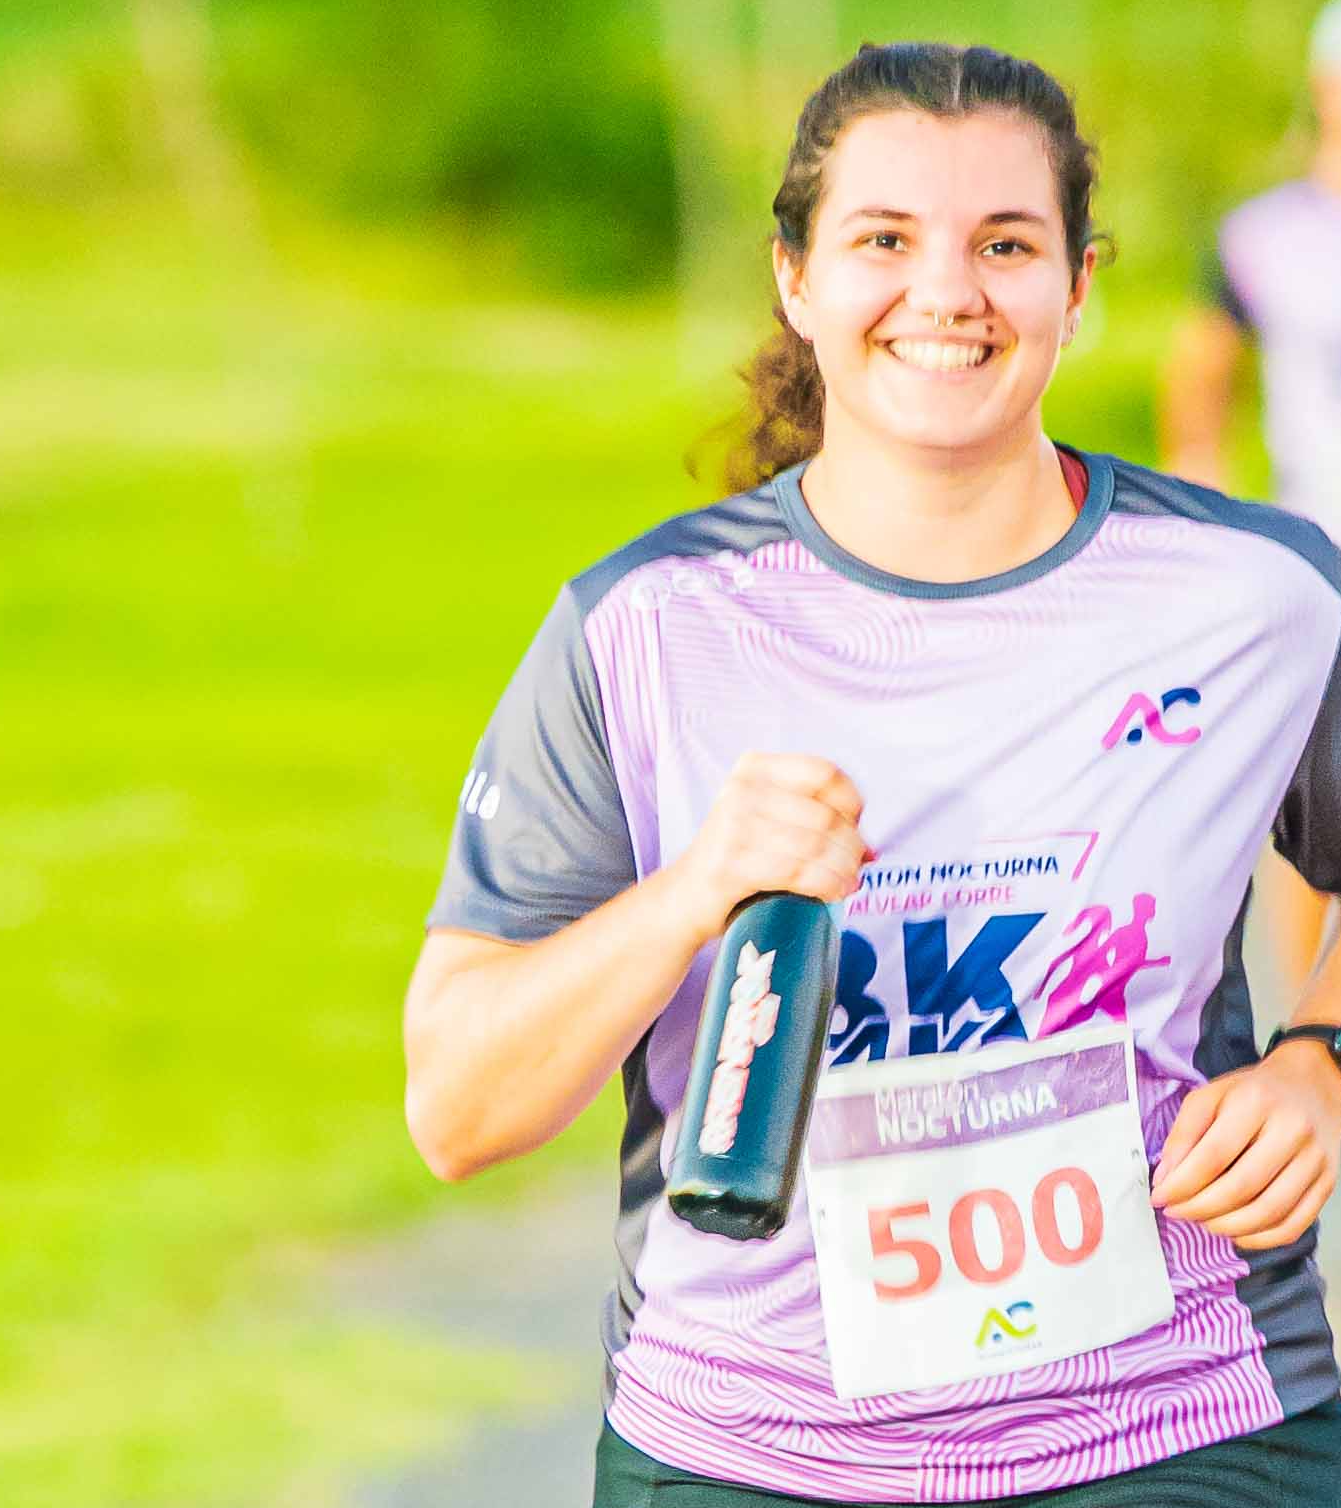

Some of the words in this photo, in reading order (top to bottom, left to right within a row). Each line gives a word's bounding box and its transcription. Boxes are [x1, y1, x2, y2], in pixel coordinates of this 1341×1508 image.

[859, 865, 921, 891] ATON
[930, 855, 1060, 885] NOCTURNA
[876, 1082, 1059, 1147] NOCTURNA
[867, 1166, 1104, 1302] 500
